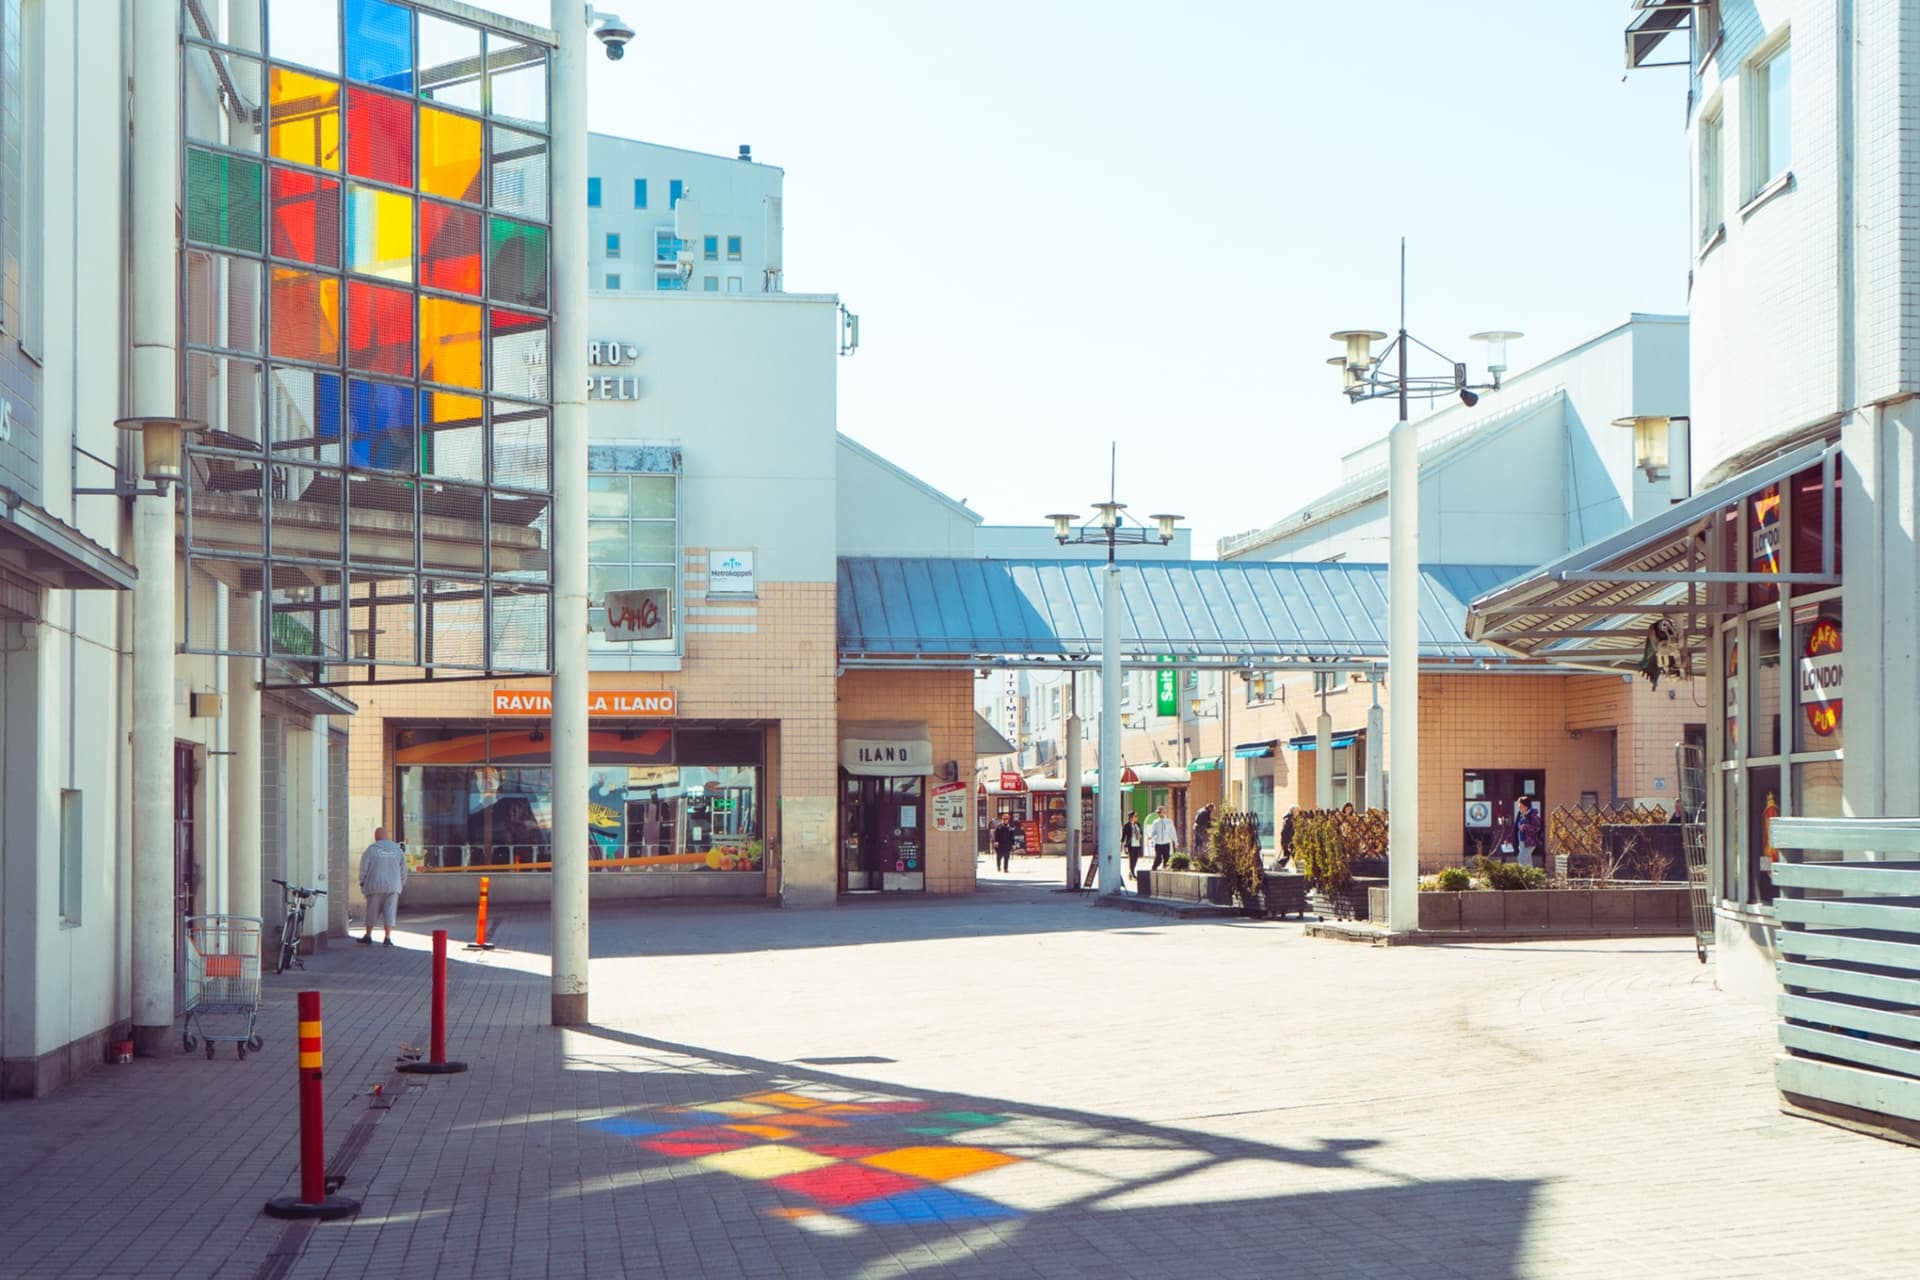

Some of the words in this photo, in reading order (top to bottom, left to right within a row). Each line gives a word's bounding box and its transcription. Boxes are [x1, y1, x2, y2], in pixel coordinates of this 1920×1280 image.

[1811, 625, 1838, 653] CAFE
[614, 697, 673, 711] ILANO
[1814, 708, 1836, 729] PUB
[859, 747, 907, 762] ILANO
